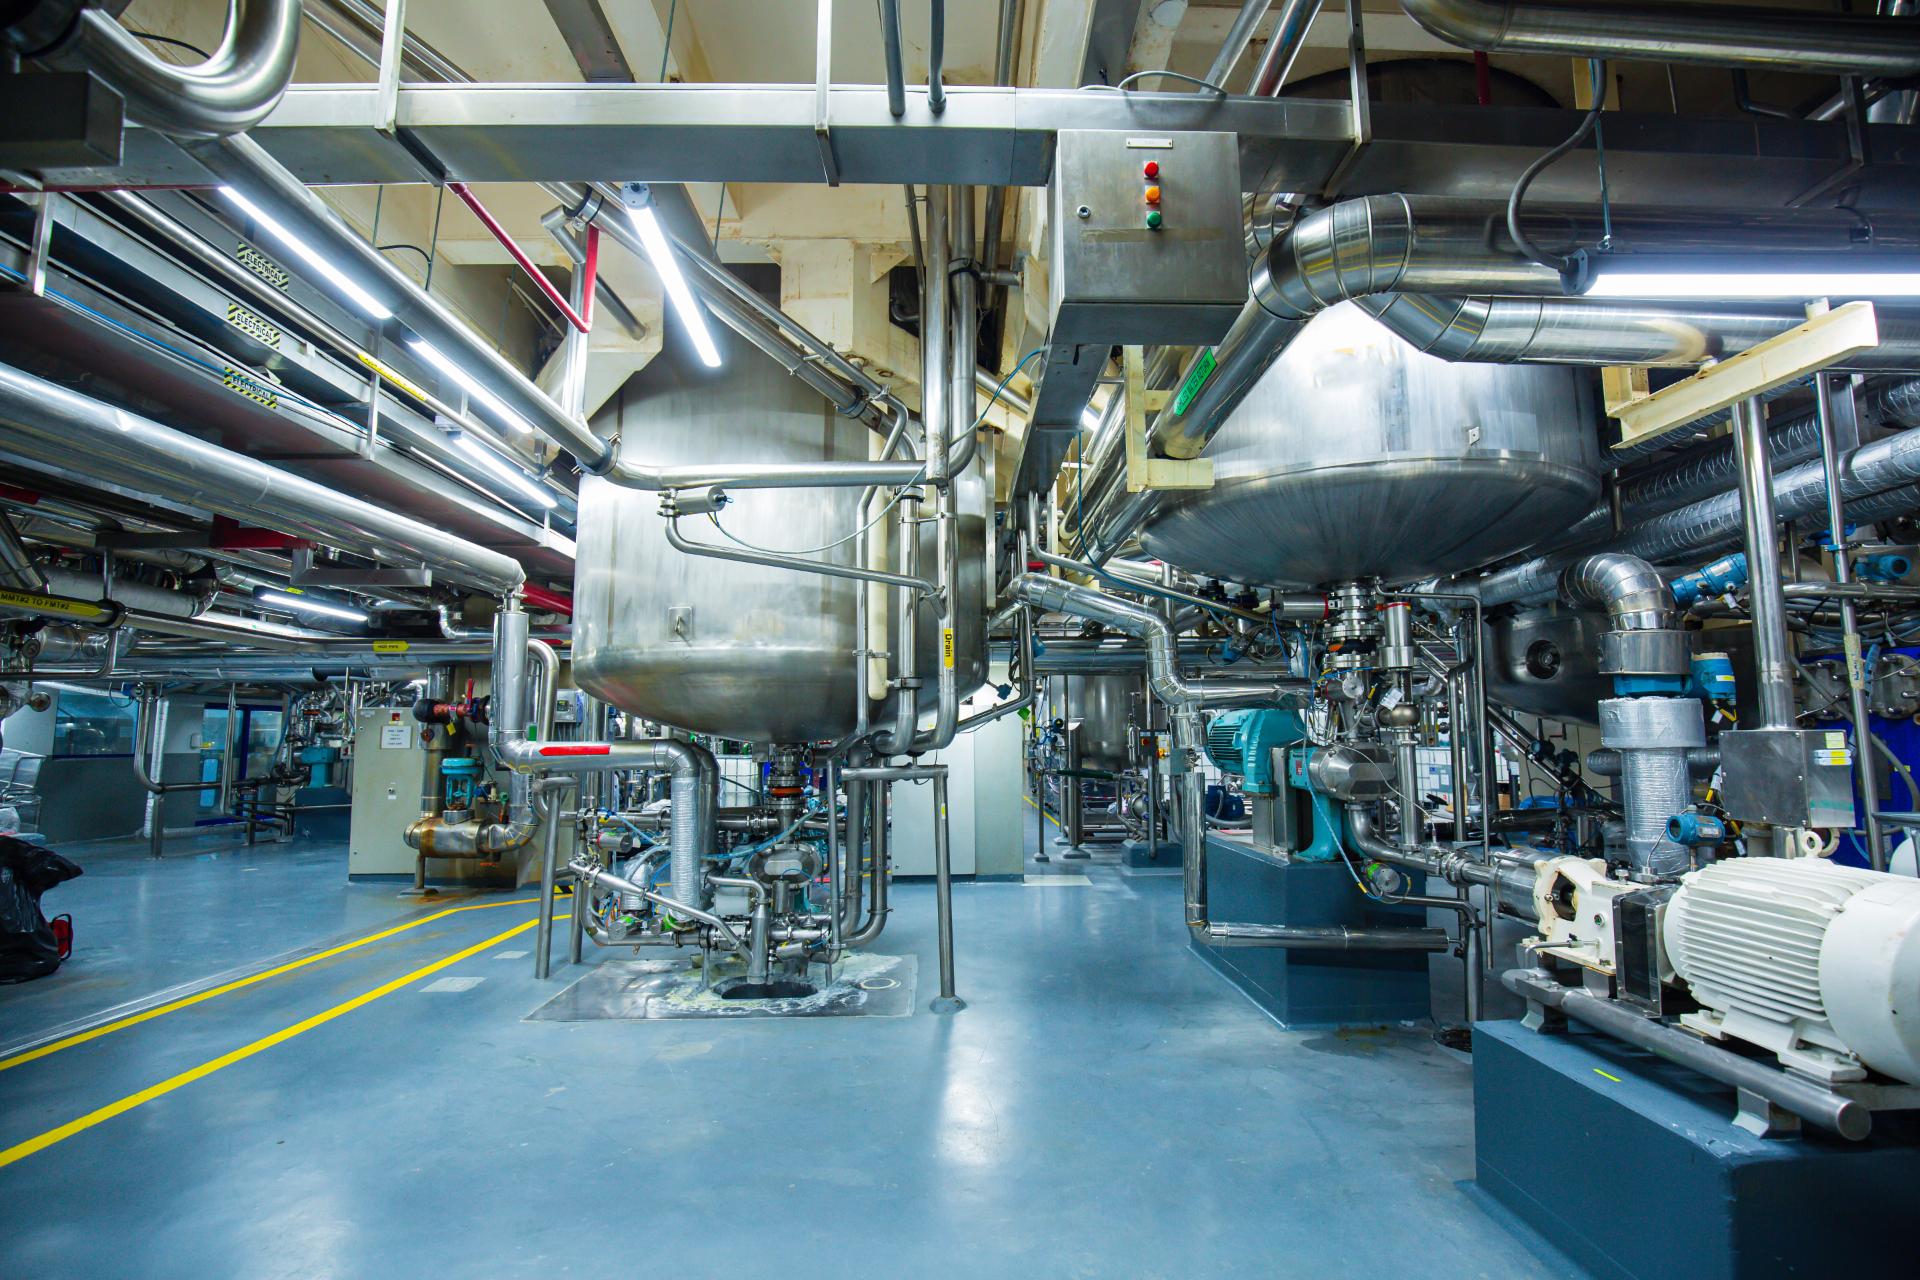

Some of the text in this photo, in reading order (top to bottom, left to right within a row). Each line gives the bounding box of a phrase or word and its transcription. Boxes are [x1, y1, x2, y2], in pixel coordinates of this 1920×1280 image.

[246, 252, 282, 281] ELECTRICAL
[236, 312, 273, 340] ELECTRICAL
[32, 598, 43, 606] TO
[945, 633, 953, 657] Drain
